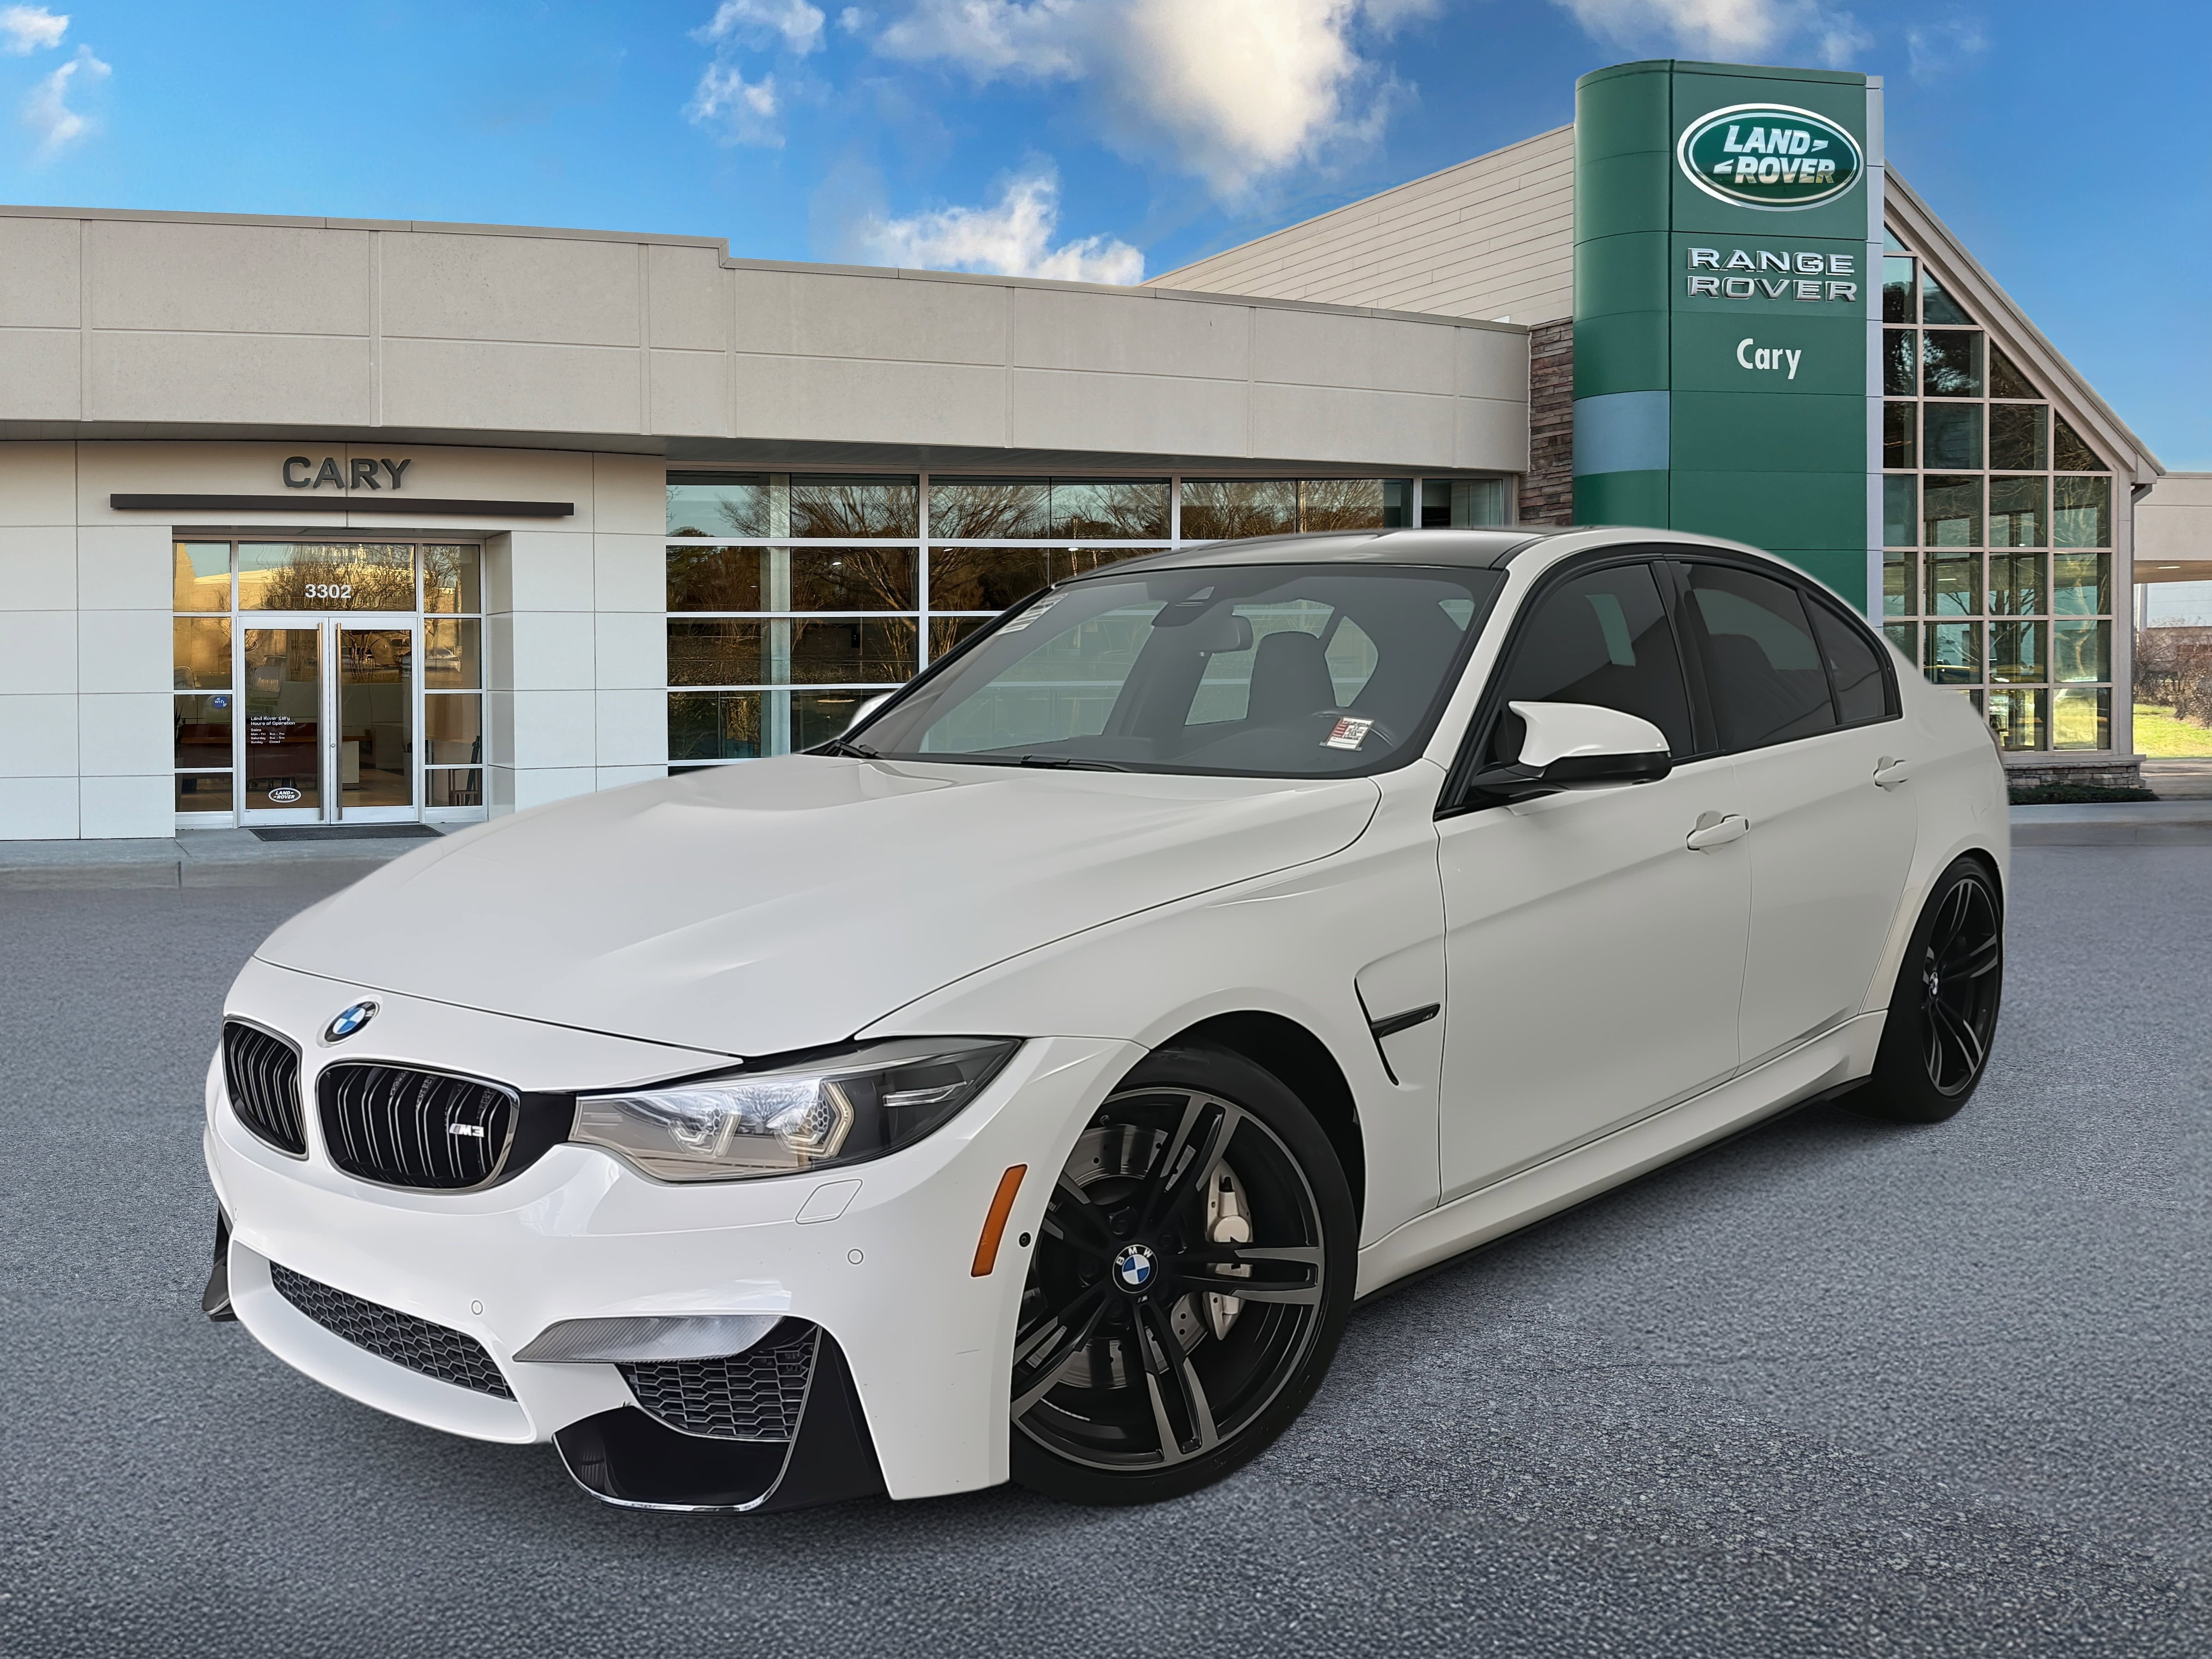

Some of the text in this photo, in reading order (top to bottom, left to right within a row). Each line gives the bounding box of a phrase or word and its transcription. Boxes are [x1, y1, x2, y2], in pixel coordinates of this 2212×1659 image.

[1723, 125, 1810, 155] LAND
[1735, 156, 1836, 184] ROVER
[1688, 248, 1855, 275] RANGE
[1688, 276, 1857, 302] ROVER
[1737, 338, 1802, 380] Cary
[283, 456, 412, 489] CARY
[305, 584, 351, 598] 3302
[1116, 1246, 1153, 1266] BMW
